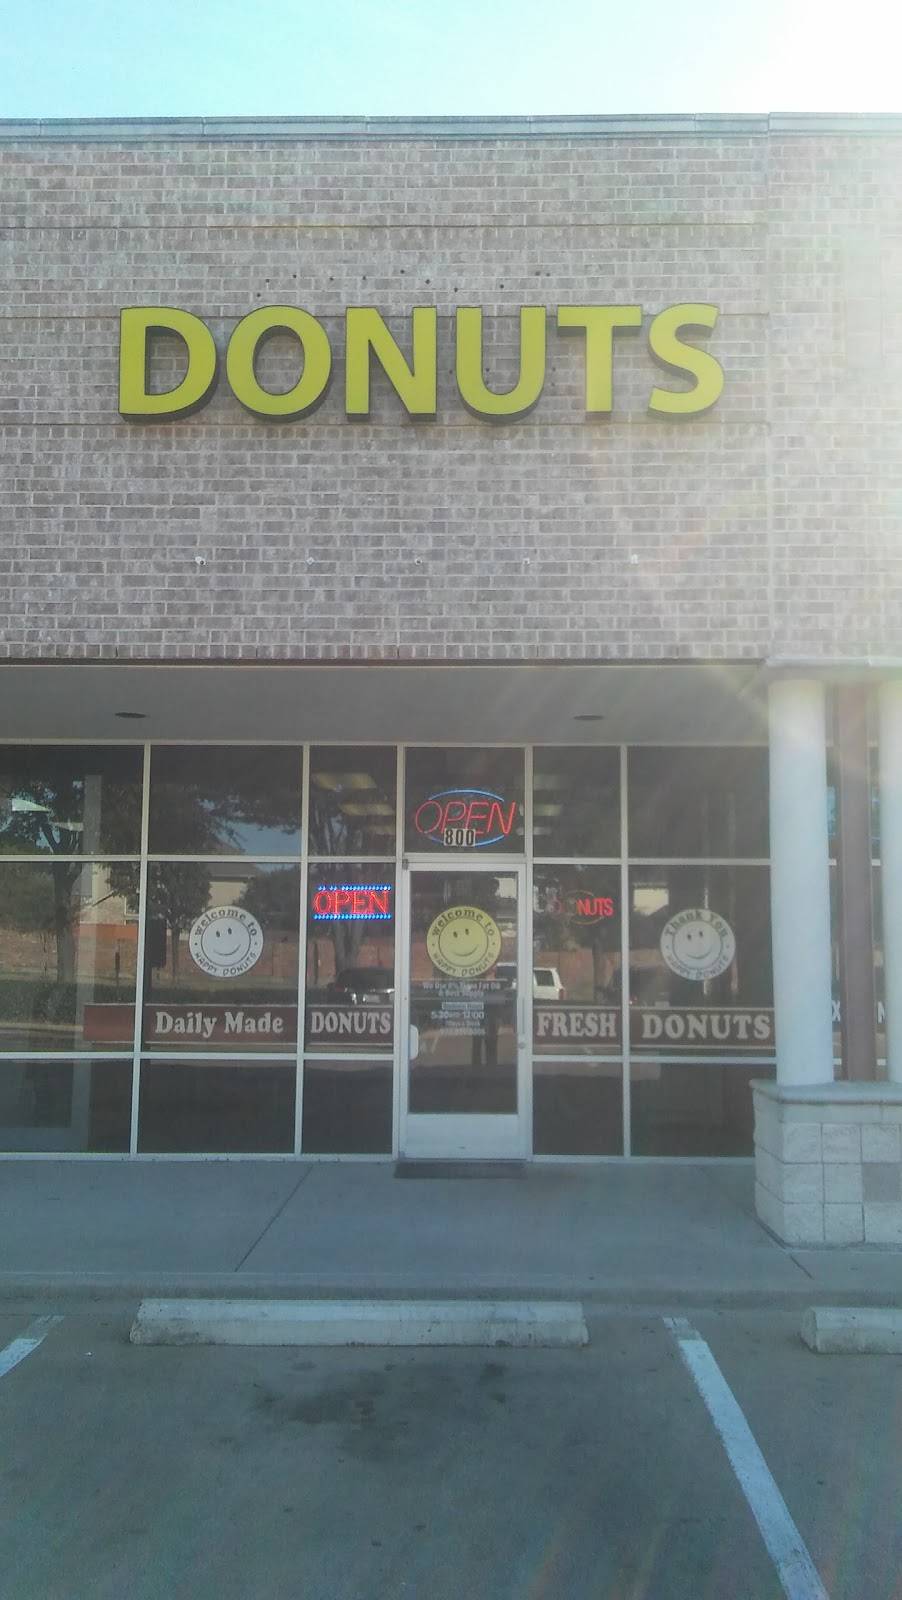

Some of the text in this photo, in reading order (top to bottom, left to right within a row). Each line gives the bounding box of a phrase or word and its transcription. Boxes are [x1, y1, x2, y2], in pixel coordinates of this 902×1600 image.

[118, 303, 725, 420] DONUTS
[415, 800, 516, 835] OPEN
[444, 829, 475, 846] 800
[312, 889, 389, 914] OPEN
[247, 922, 258, 936] to
[485, 922, 495, 936] to
[195, 951, 258, 976] HAPPY DONUTS
[155, 1011, 284, 1038] Daily Made
[310, 1012, 392, 1034] DONUTS
[536, 1012, 617, 1037] FRESH
[642, 1014, 771, 1039] DONUTS
